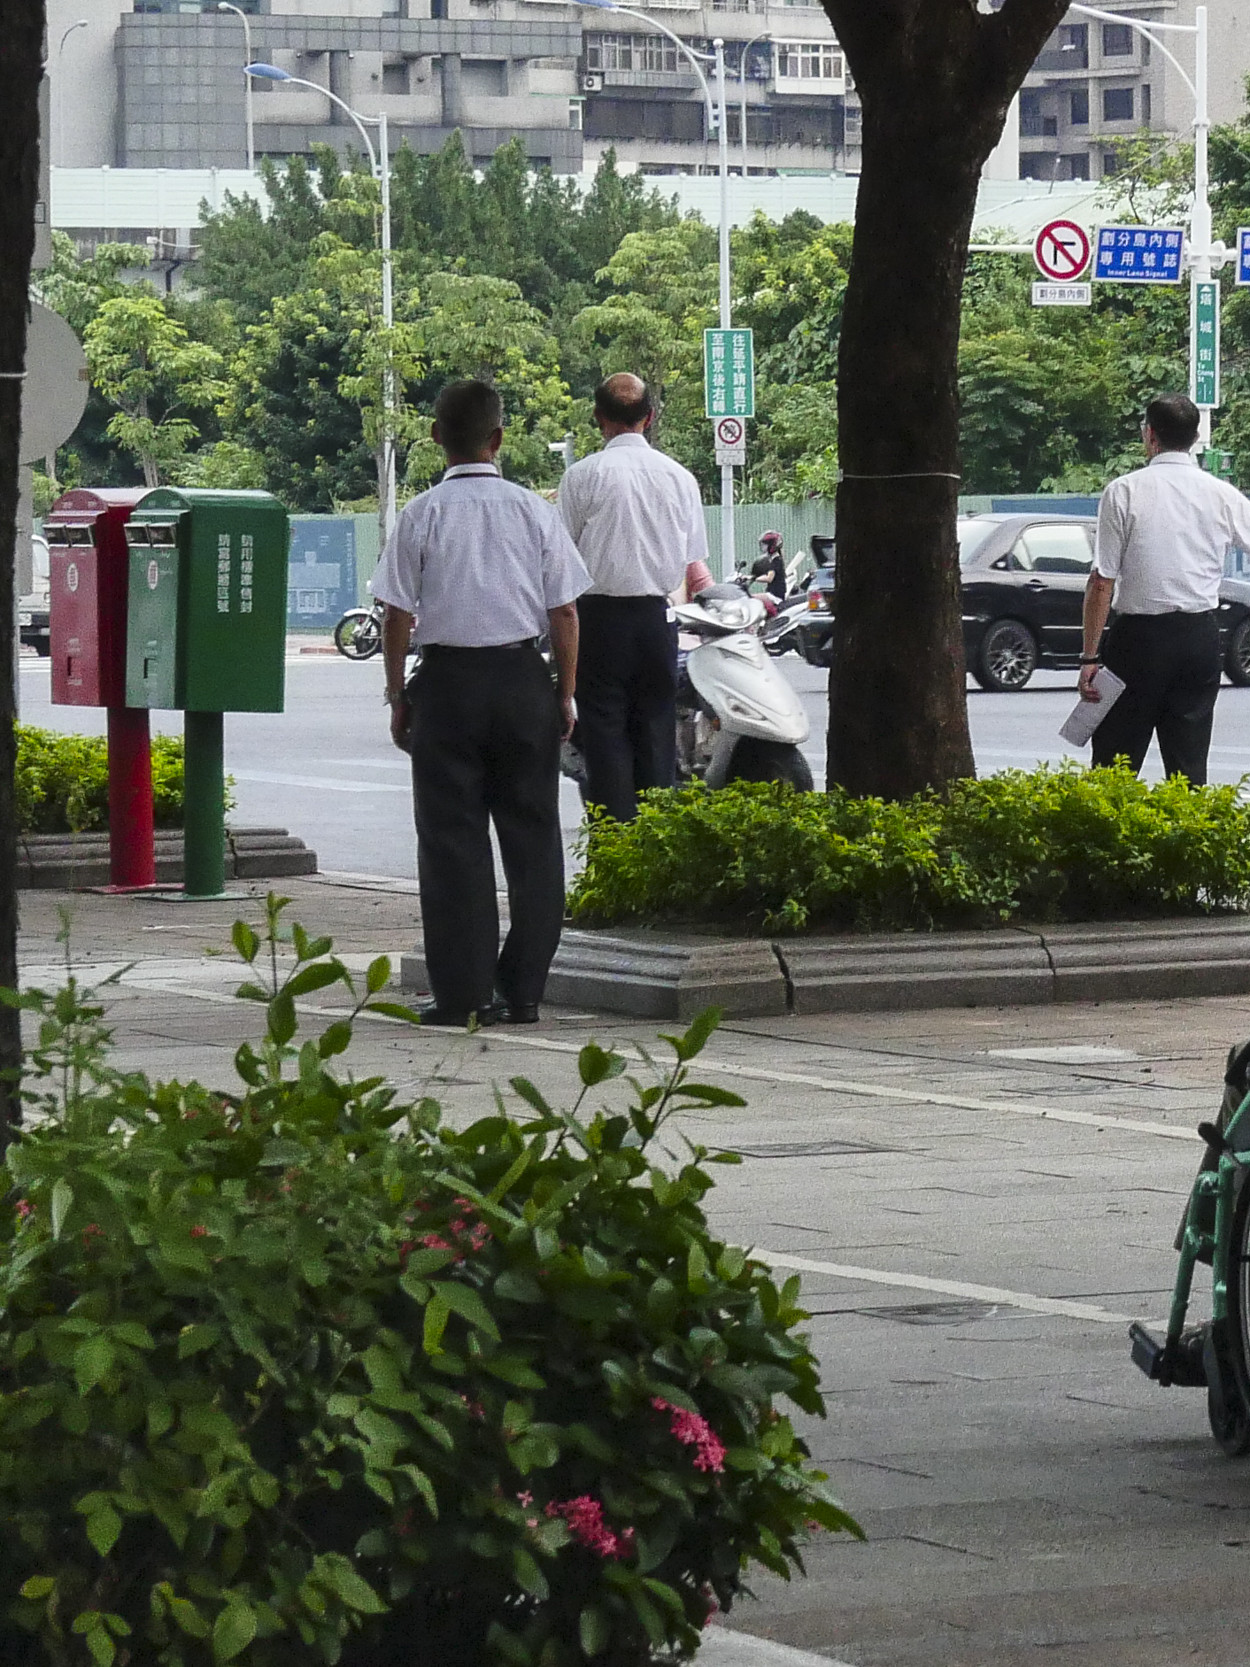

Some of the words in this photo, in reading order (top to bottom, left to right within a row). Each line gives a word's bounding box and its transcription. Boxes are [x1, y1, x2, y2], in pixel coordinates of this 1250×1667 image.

[1101, 232, 1178, 248] 劃分島內側
[1101, 252, 1176, 267] 專用號誌
[1127, 269, 1143, 277] Lane
[1145, 270, 1167, 278] Signal
[1039, 289, 1085, 299] 劃分島內側
